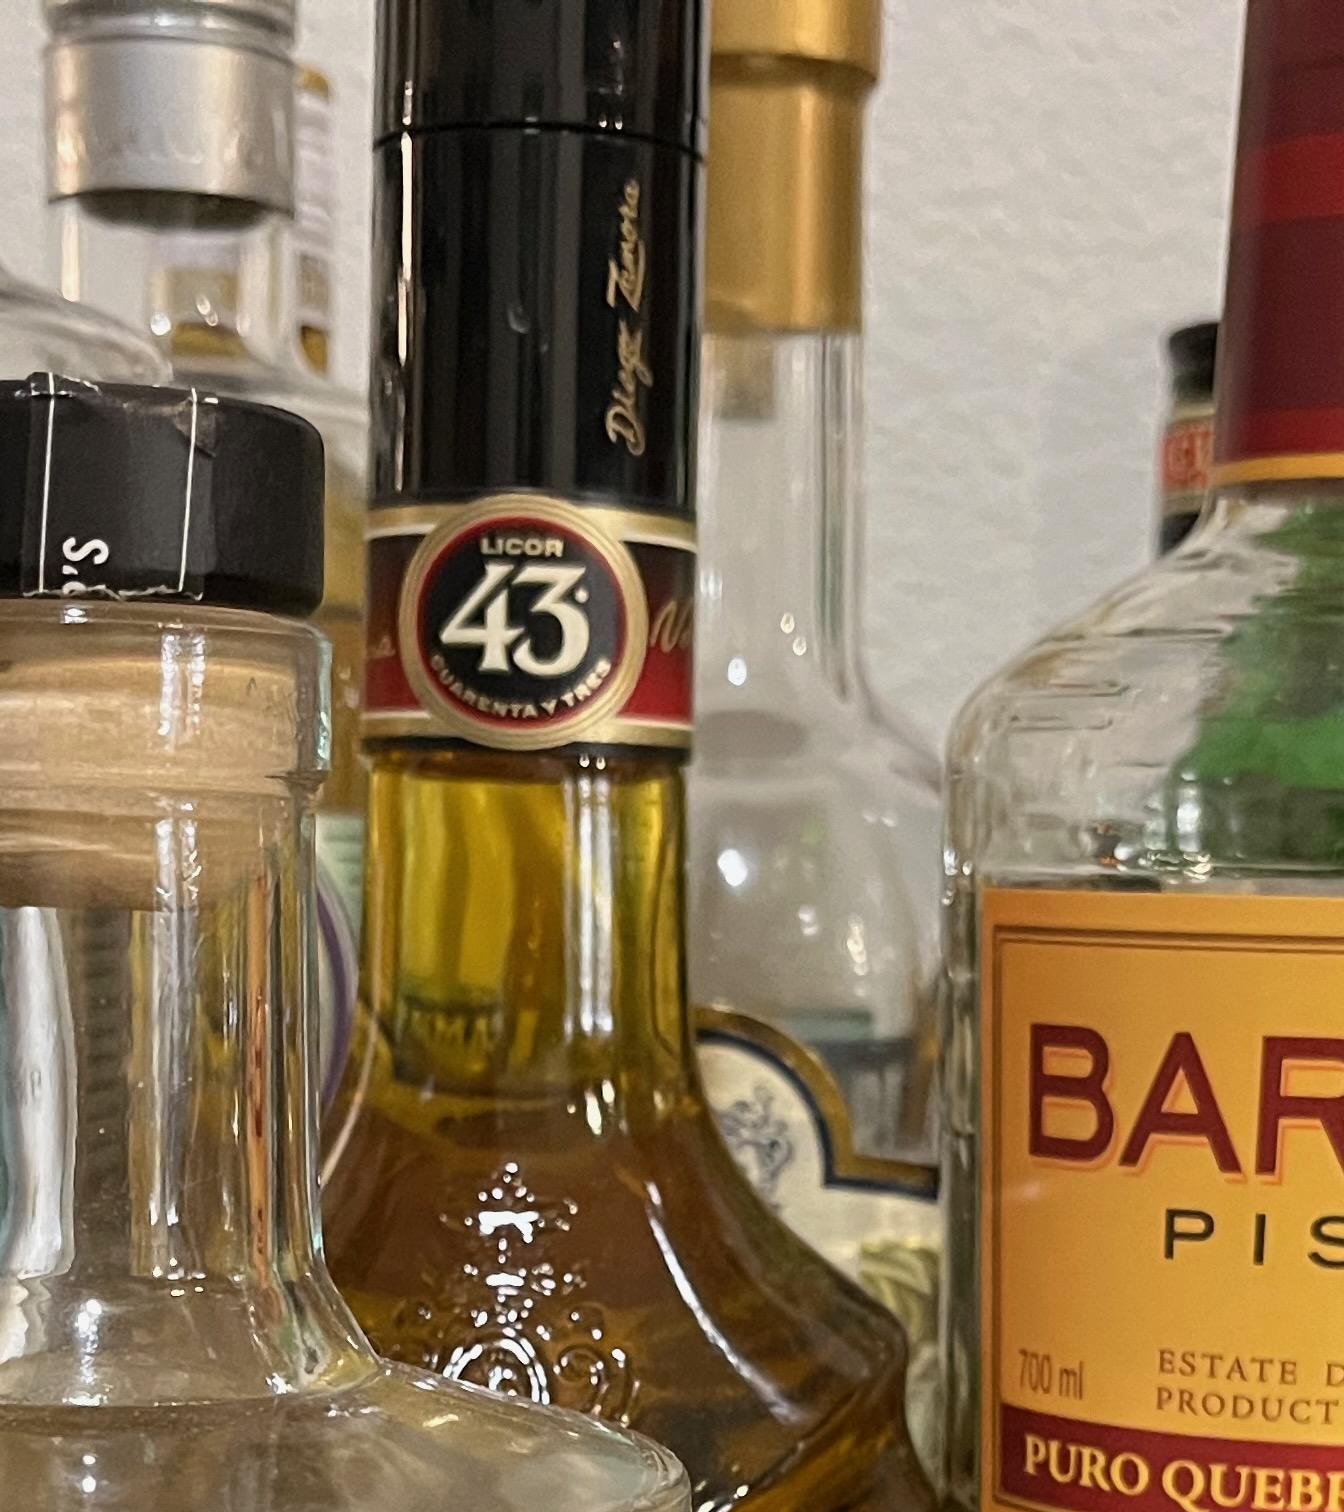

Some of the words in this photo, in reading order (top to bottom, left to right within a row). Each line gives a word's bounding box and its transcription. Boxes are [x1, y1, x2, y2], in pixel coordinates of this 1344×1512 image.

[480, 537, 565, 558] LICOR
[438, 562, 590, 679] 43
[1017, 1347, 1052, 1397] 700
[1058, 1360, 1085, 1401] ml
[1157, 1348, 1299, 1387] ESTATE
[1156, 1386, 1340, 1426] PRODUCT
[1023, 1433, 1150, 1497] PURO
